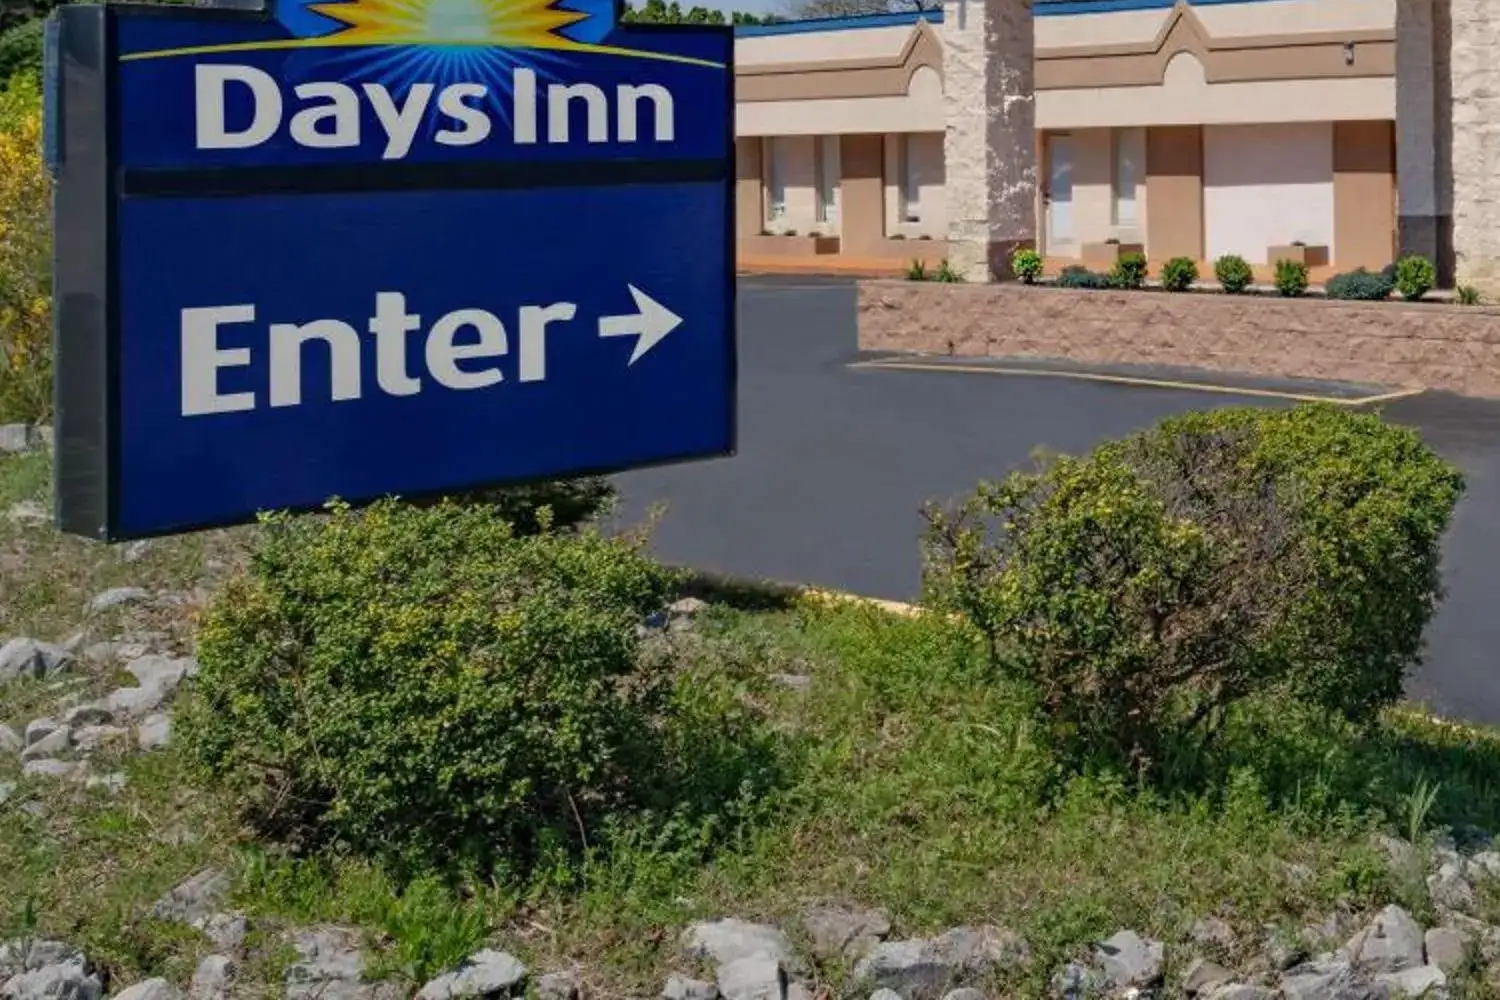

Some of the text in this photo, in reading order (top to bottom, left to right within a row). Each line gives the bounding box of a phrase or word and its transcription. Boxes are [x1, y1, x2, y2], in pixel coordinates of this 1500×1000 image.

[195, 63, 676, 160] Days Inn
[180, 291, 577, 417] Enter
